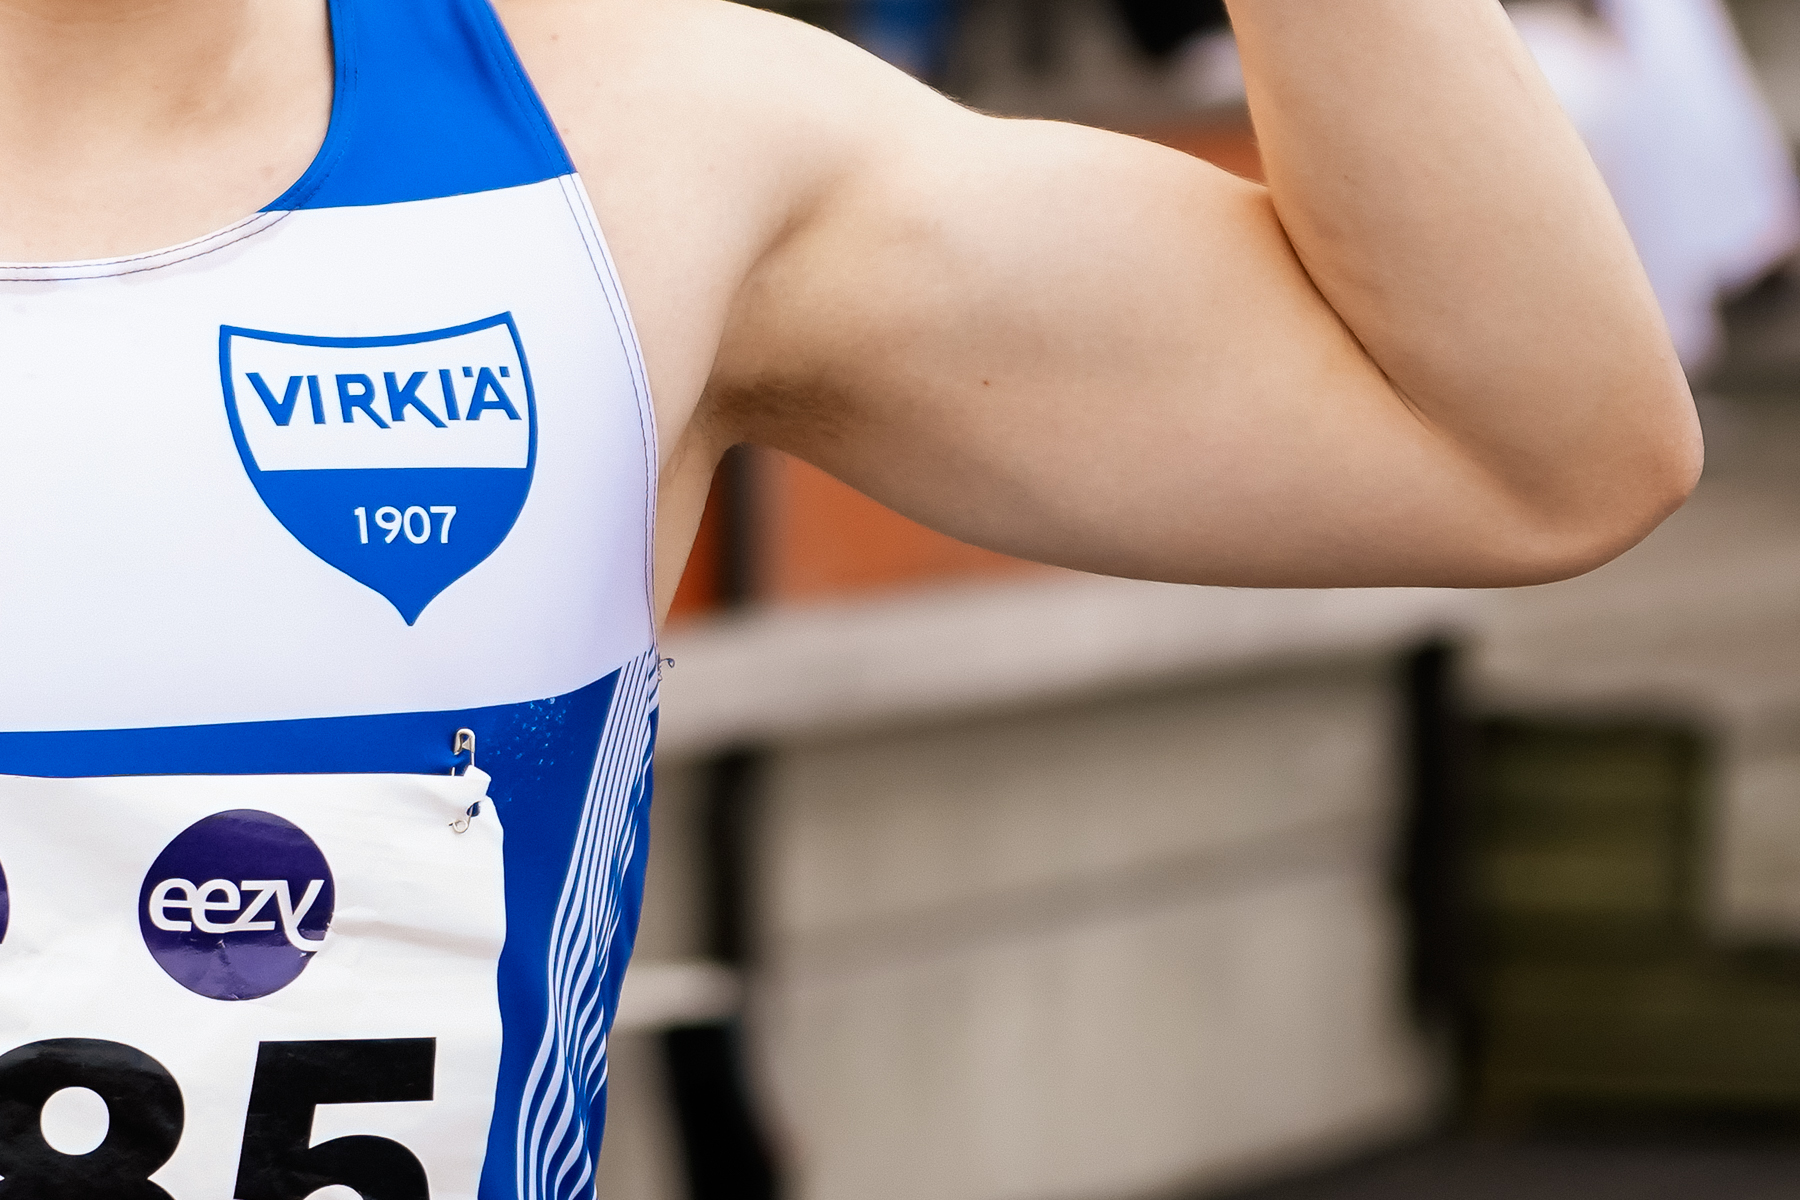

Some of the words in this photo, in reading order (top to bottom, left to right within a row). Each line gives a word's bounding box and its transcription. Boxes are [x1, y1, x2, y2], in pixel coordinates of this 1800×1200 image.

[245, 366, 522, 428] VIRKIÄ
[354, 505, 457, 544] 1907
[150, 877, 328, 953] eezy
